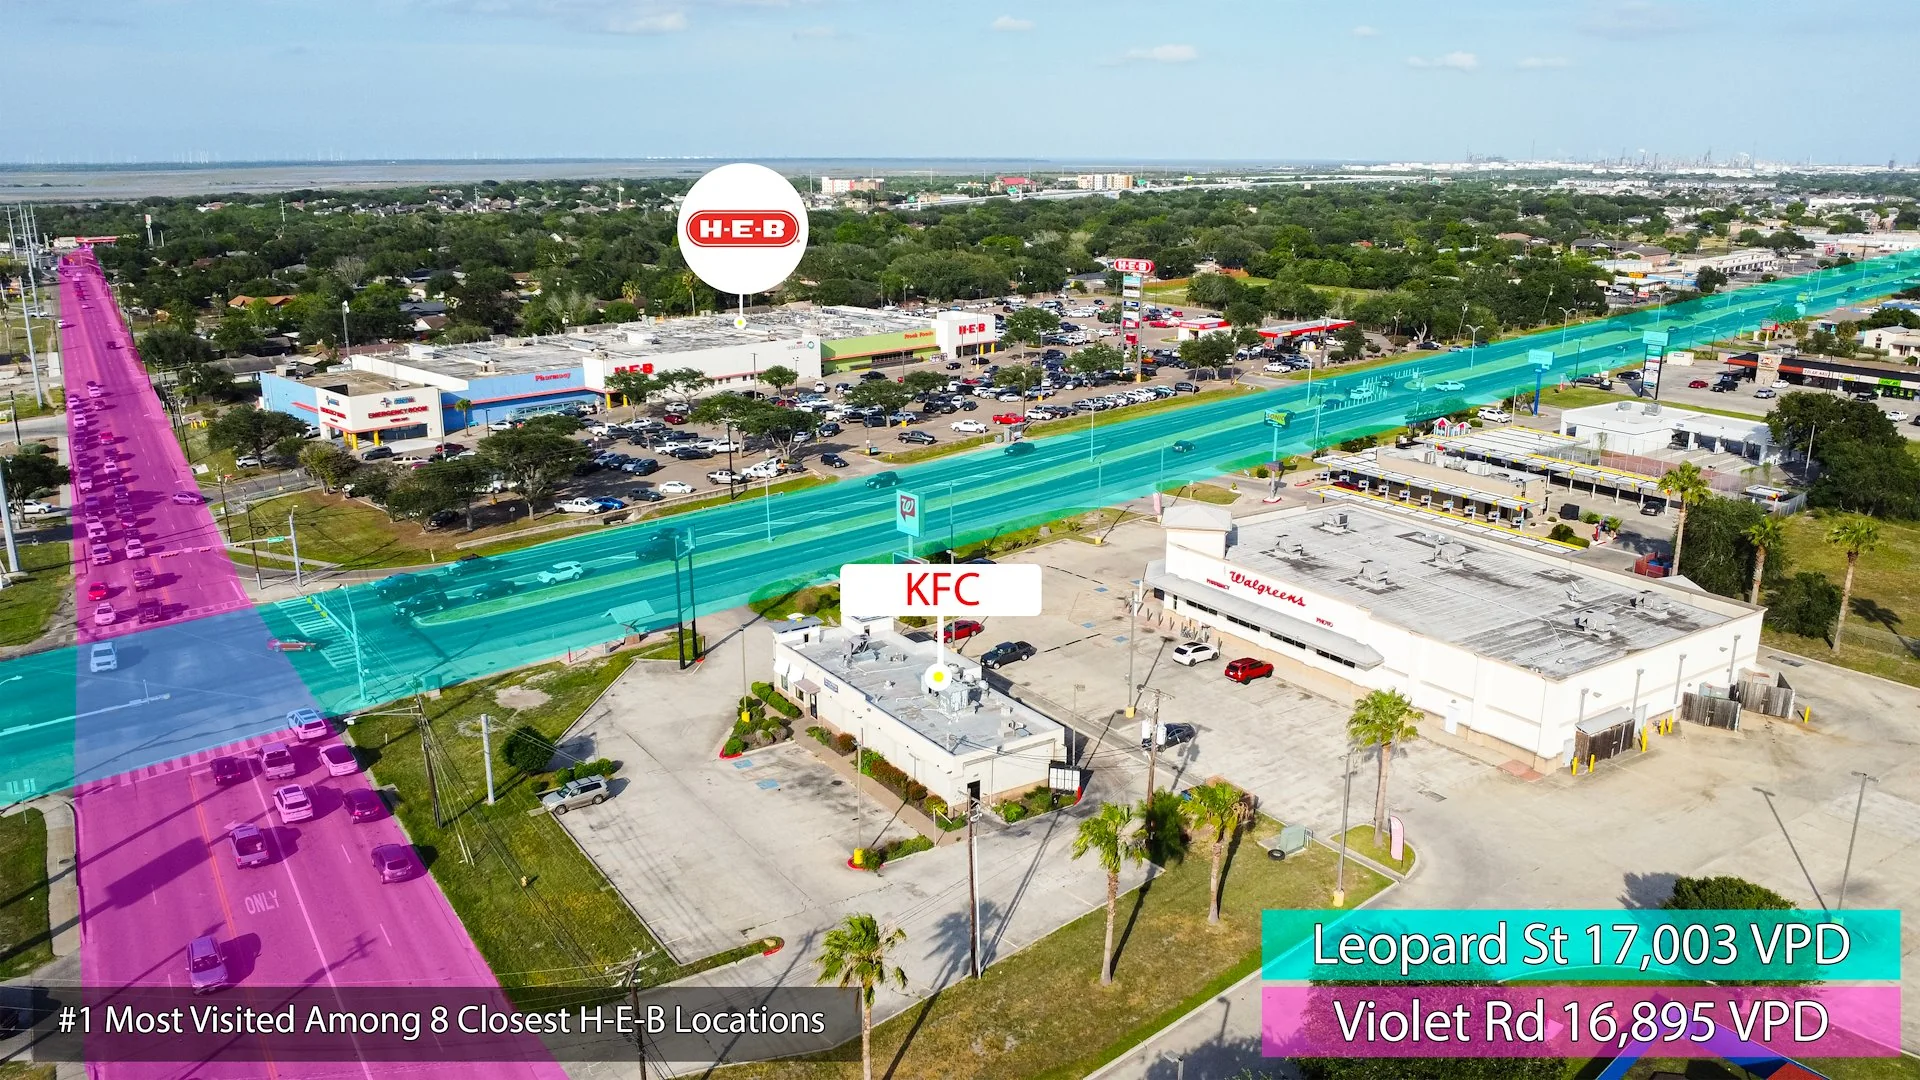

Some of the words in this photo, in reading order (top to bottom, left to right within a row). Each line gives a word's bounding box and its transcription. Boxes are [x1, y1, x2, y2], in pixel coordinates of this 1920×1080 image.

[1118, 261, 1147, 272] H-E-B
[958, 323, 986, 335] H-E-B
[535, 372, 571, 382] Pharmacy
[367, 406, 408, 419] EMERGENCY
[407, 405, 430, 414] ROOM
[1229, 570, 1307, 607] Walgreens
[244, 889, 280, 915] ONLY
